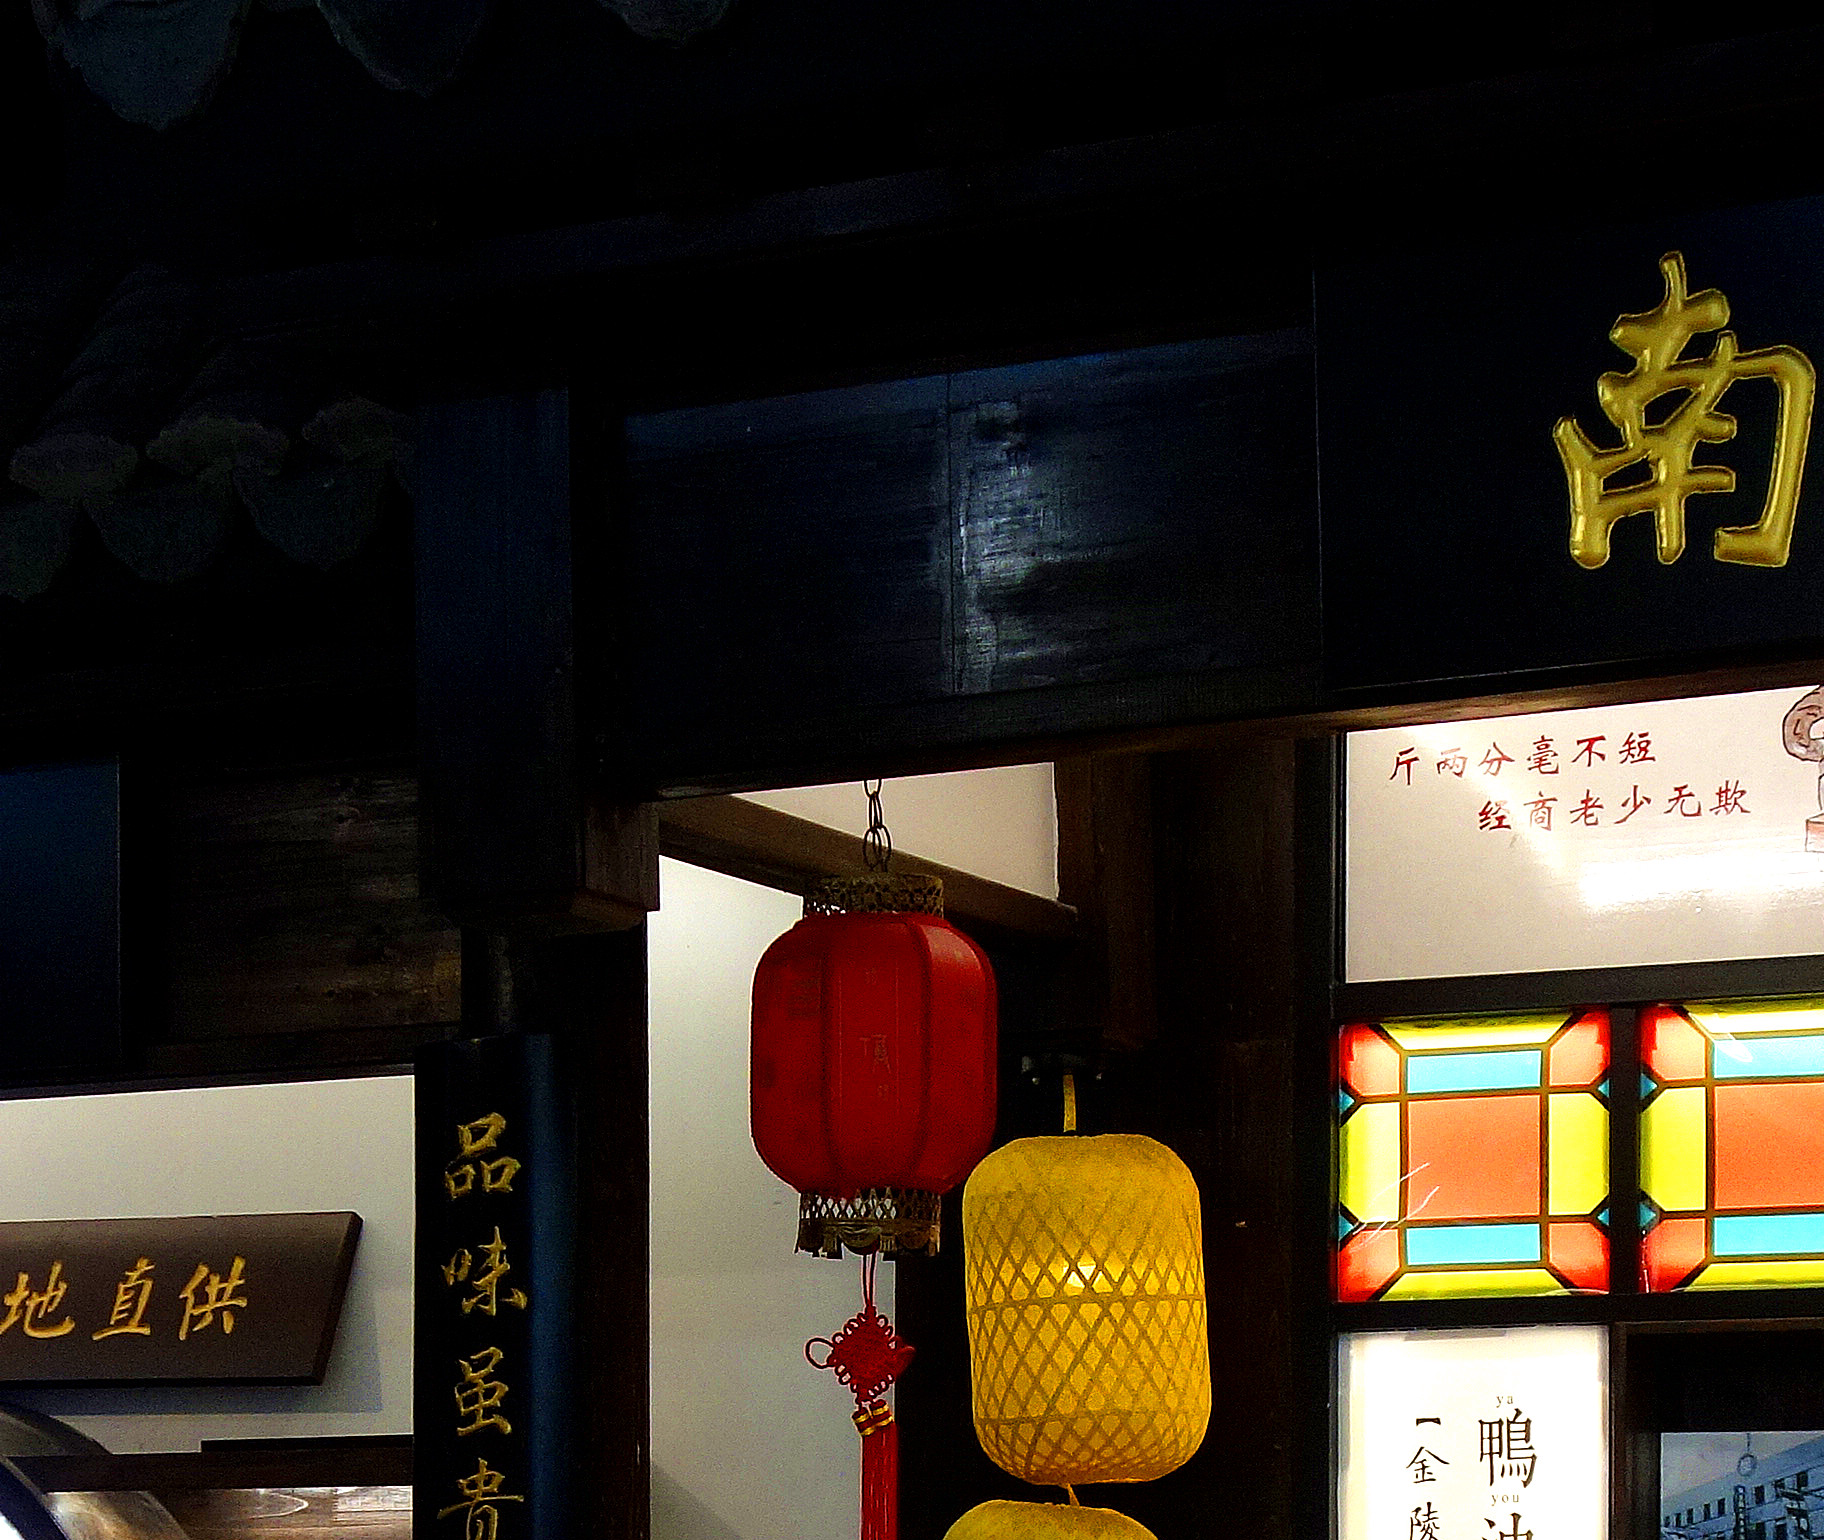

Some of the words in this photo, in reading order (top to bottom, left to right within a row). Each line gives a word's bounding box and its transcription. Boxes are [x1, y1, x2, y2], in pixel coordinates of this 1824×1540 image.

[1388, 731, 1658, 786] 斤两分毫不短
[1478, 783, 1752, 835] 经商老少无欺
[1496, 1394, 1514, 1408] ya
[1490, 1491, 1521, 1506] you
